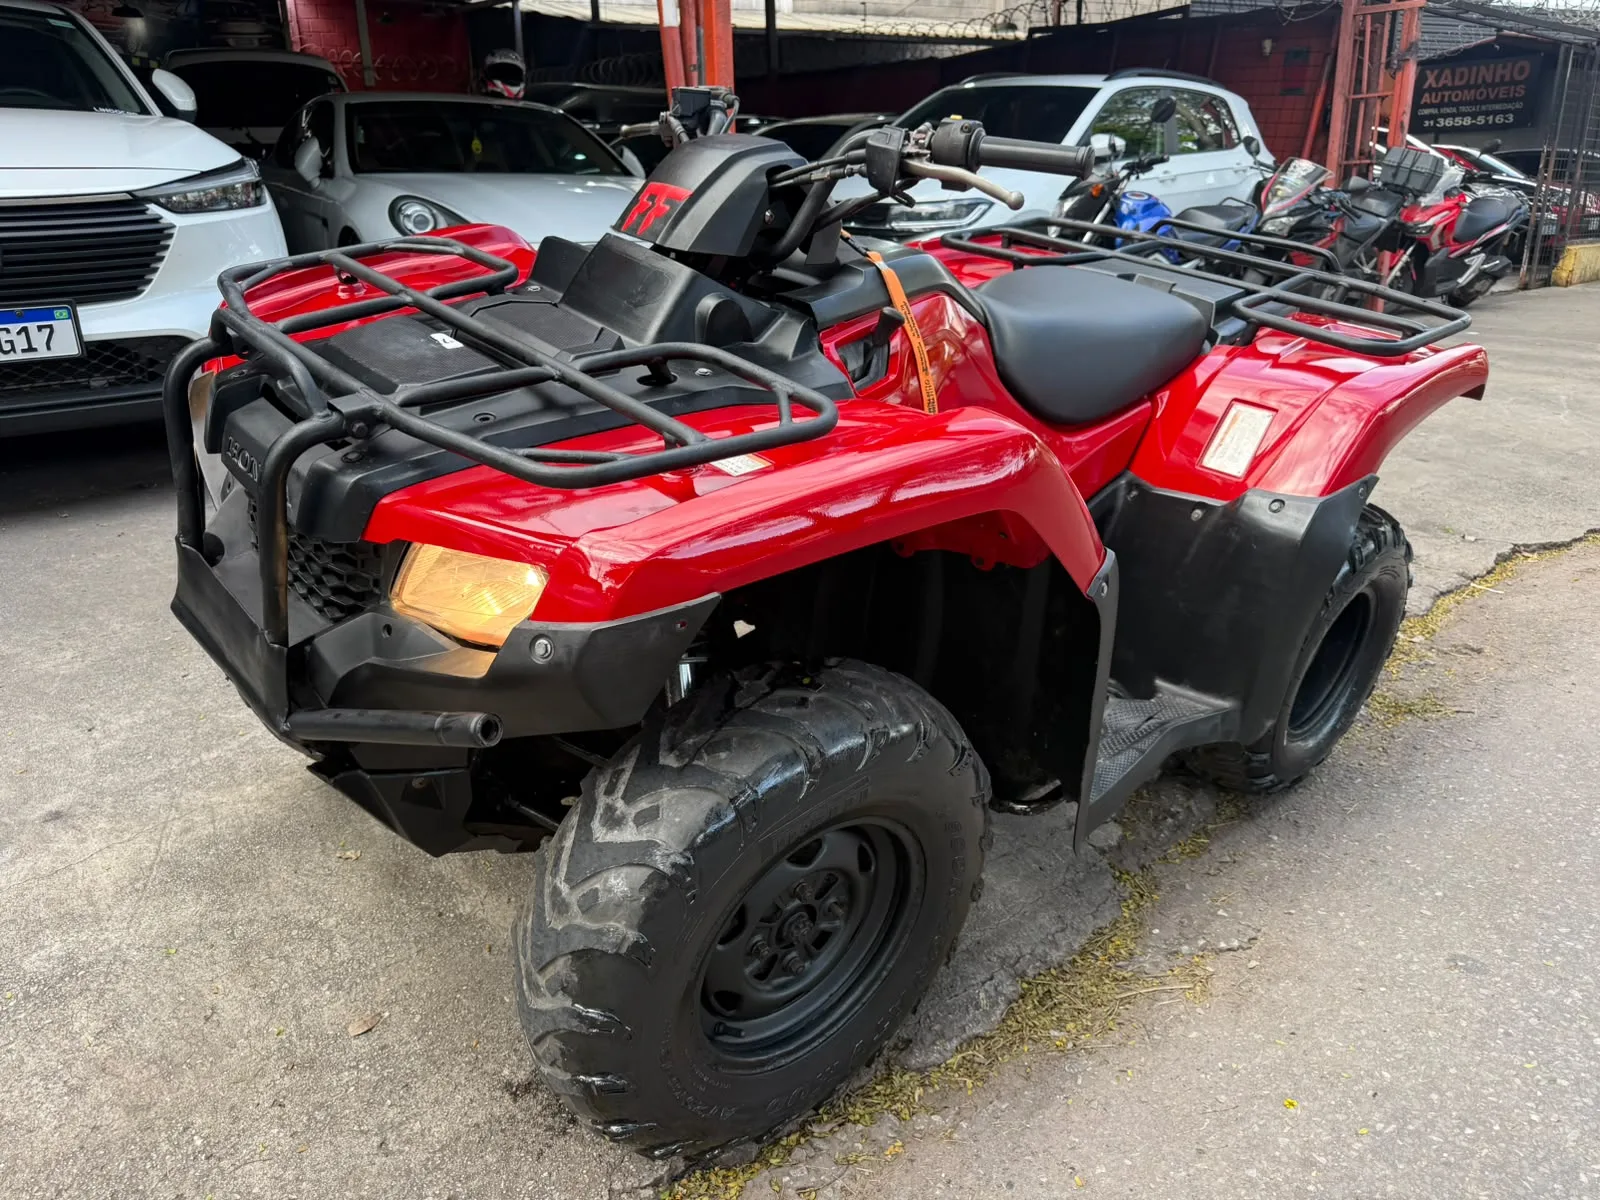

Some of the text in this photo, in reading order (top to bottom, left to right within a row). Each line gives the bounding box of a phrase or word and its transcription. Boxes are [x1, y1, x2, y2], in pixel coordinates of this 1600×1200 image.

[1421, 84, 1525, 104] AUTOMÓVEIS
[1436, 113, 1514, 127] 3658-5163
[0, 323, 55, 355] G17
